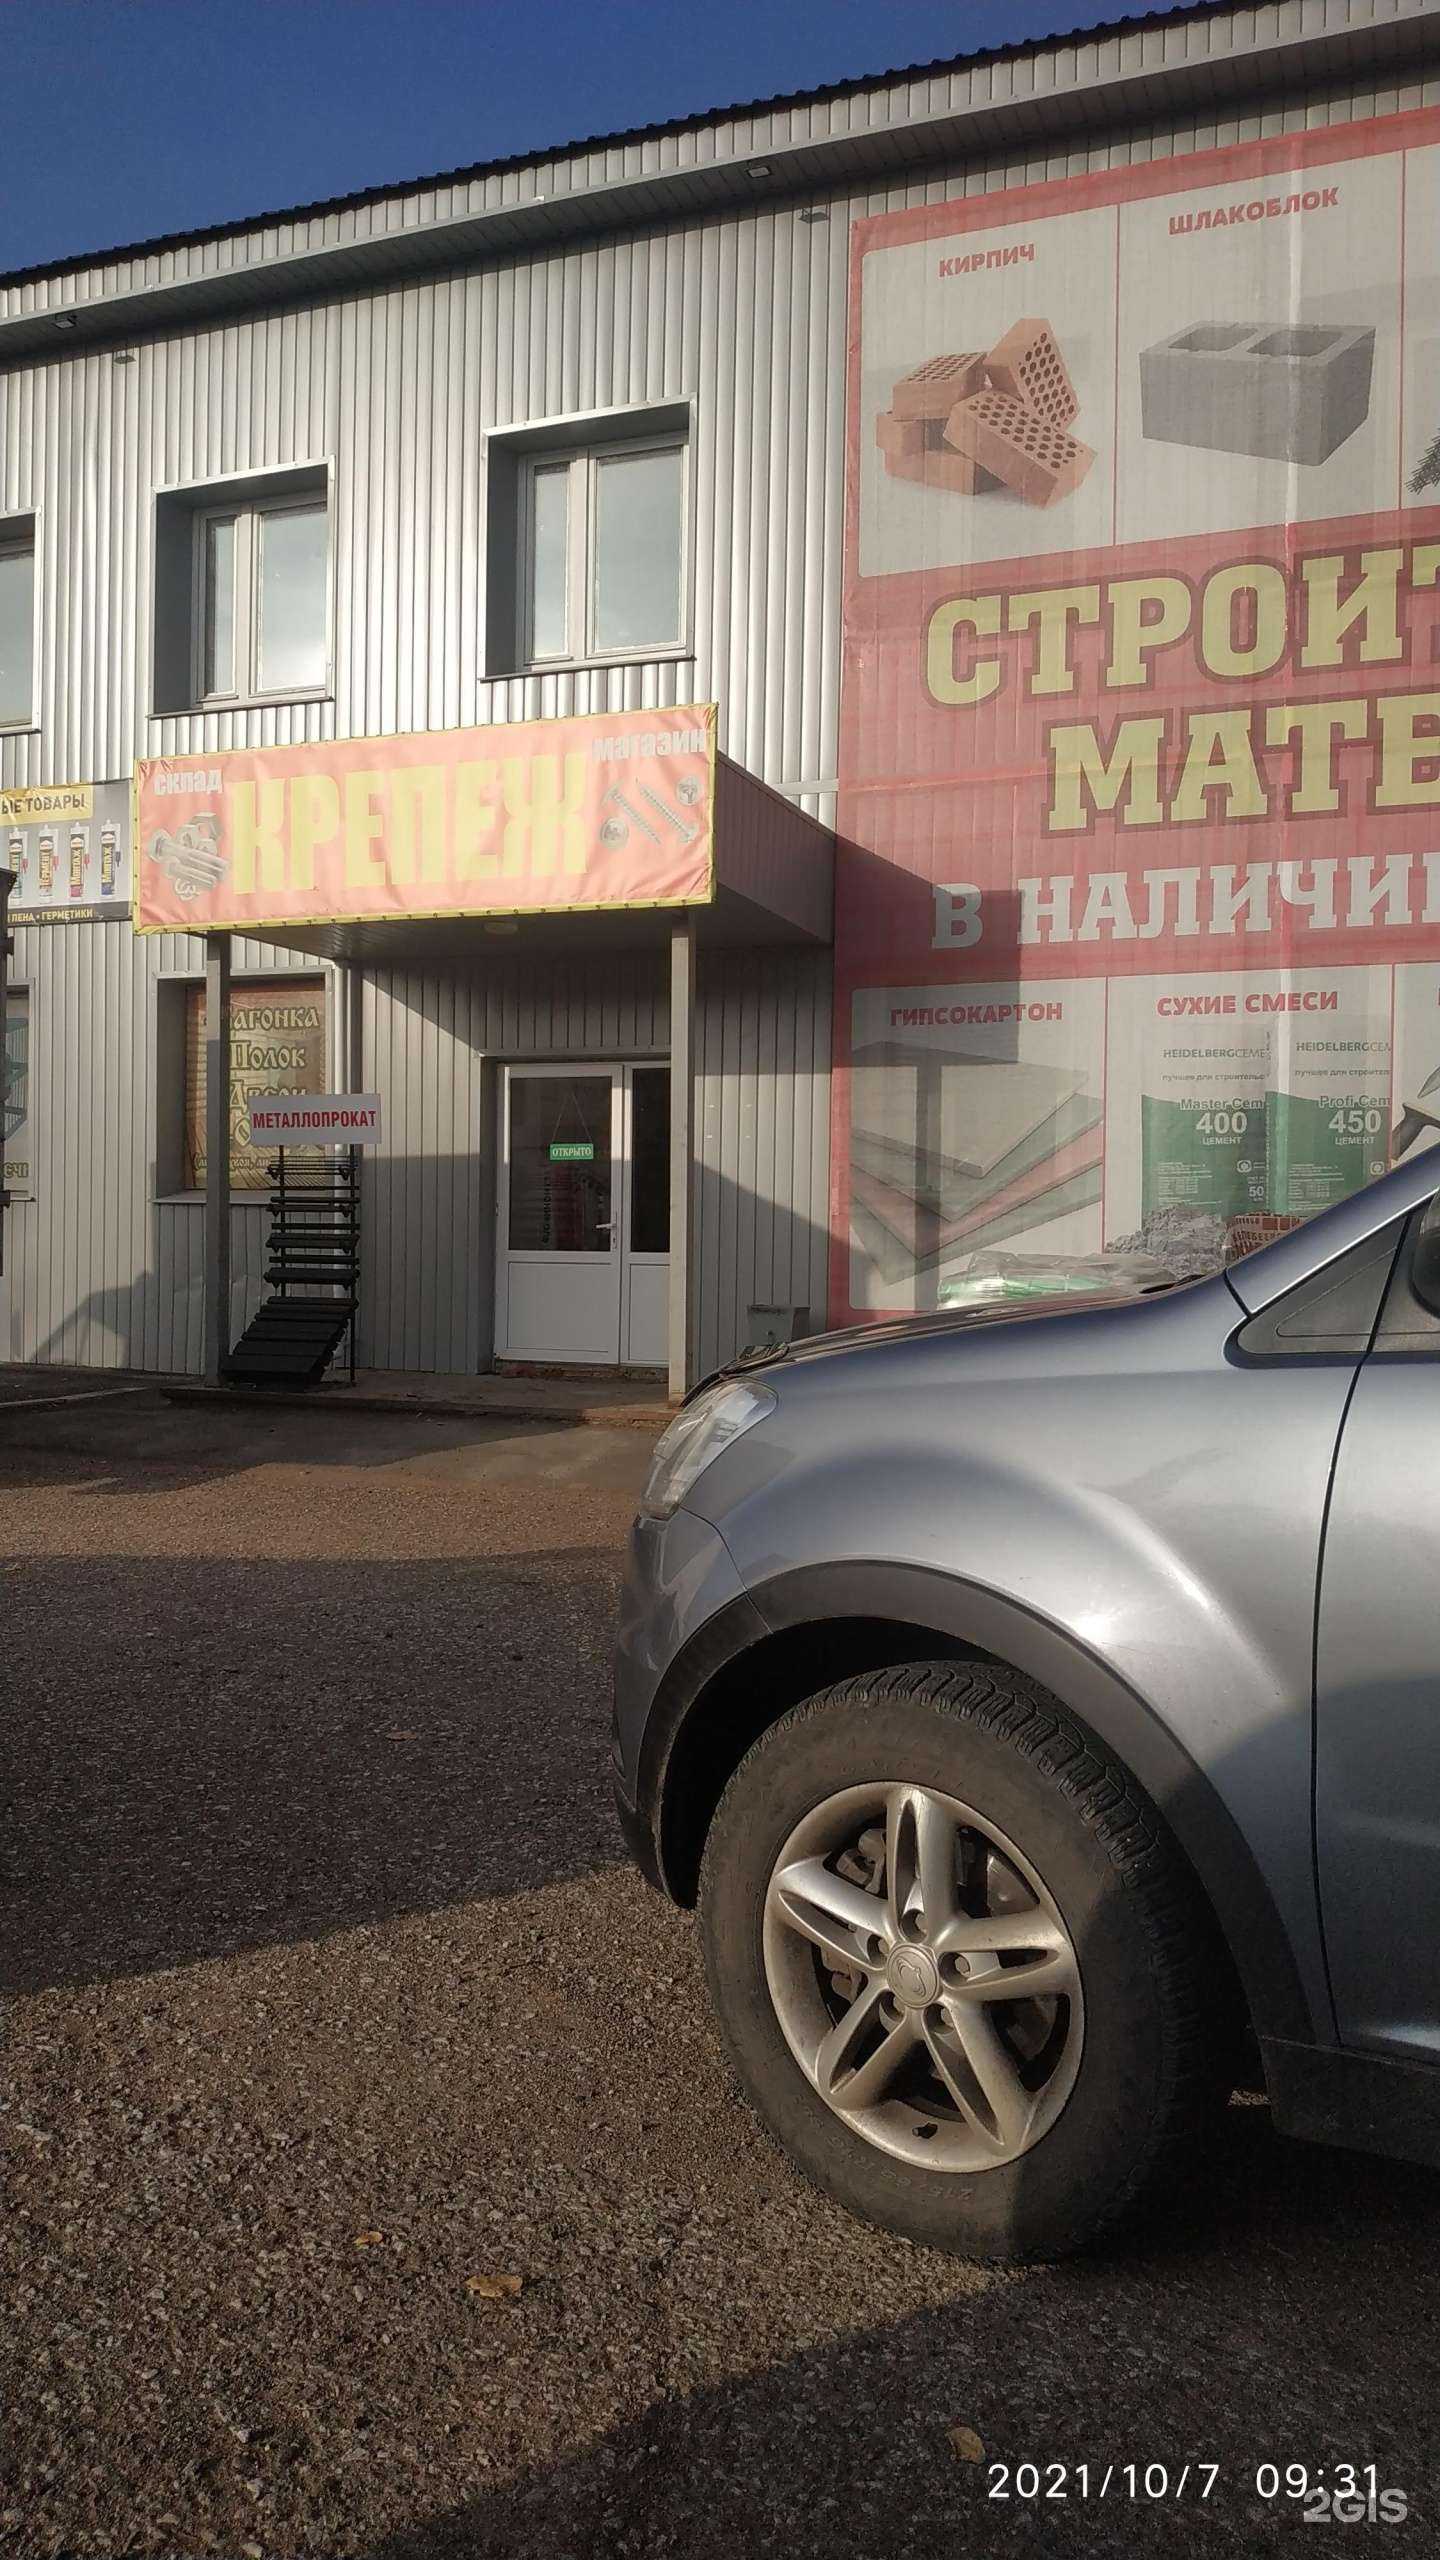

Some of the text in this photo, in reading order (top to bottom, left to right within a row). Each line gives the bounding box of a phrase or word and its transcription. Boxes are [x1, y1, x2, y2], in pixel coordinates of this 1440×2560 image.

[1168, 187, 1340, 235] ШЛАКОБЛОК
[938, 244, 1035, 277] КИРПИЧ
[592, 728, 705, 761] магазин
[153, 769, 223, 796] склад
[25, 793, 86, 812] ТОВАРЫ
[231, 753, 590, 896] КРЕПЕЖ
[931, 852, 1440, 949] В НАЛИЧИ
[11, 912, 35, 922] ПЕНА
[41, 908, 94, 921] ГЕРМЕТИКИ
[889, 1002, 1063, 1027] ГИПСОКАРТОН
[1156, 991, 1339, 1018] СУХИЕ СМЕСИ
[252, 1110, 377, 1129] МЕТАЛЛОПРОКАТ
[1195, 1111, 1248, 1134] 400
[1328, 1109, 1382, 1134] 450
[552, 1146, 592, 1157] ОТКРЫТО
[1202, 1136, 1243, 1146] ЦЕМЕНТ
[1334, 1136, 1377, 1146] ЦЕМЕНТ
